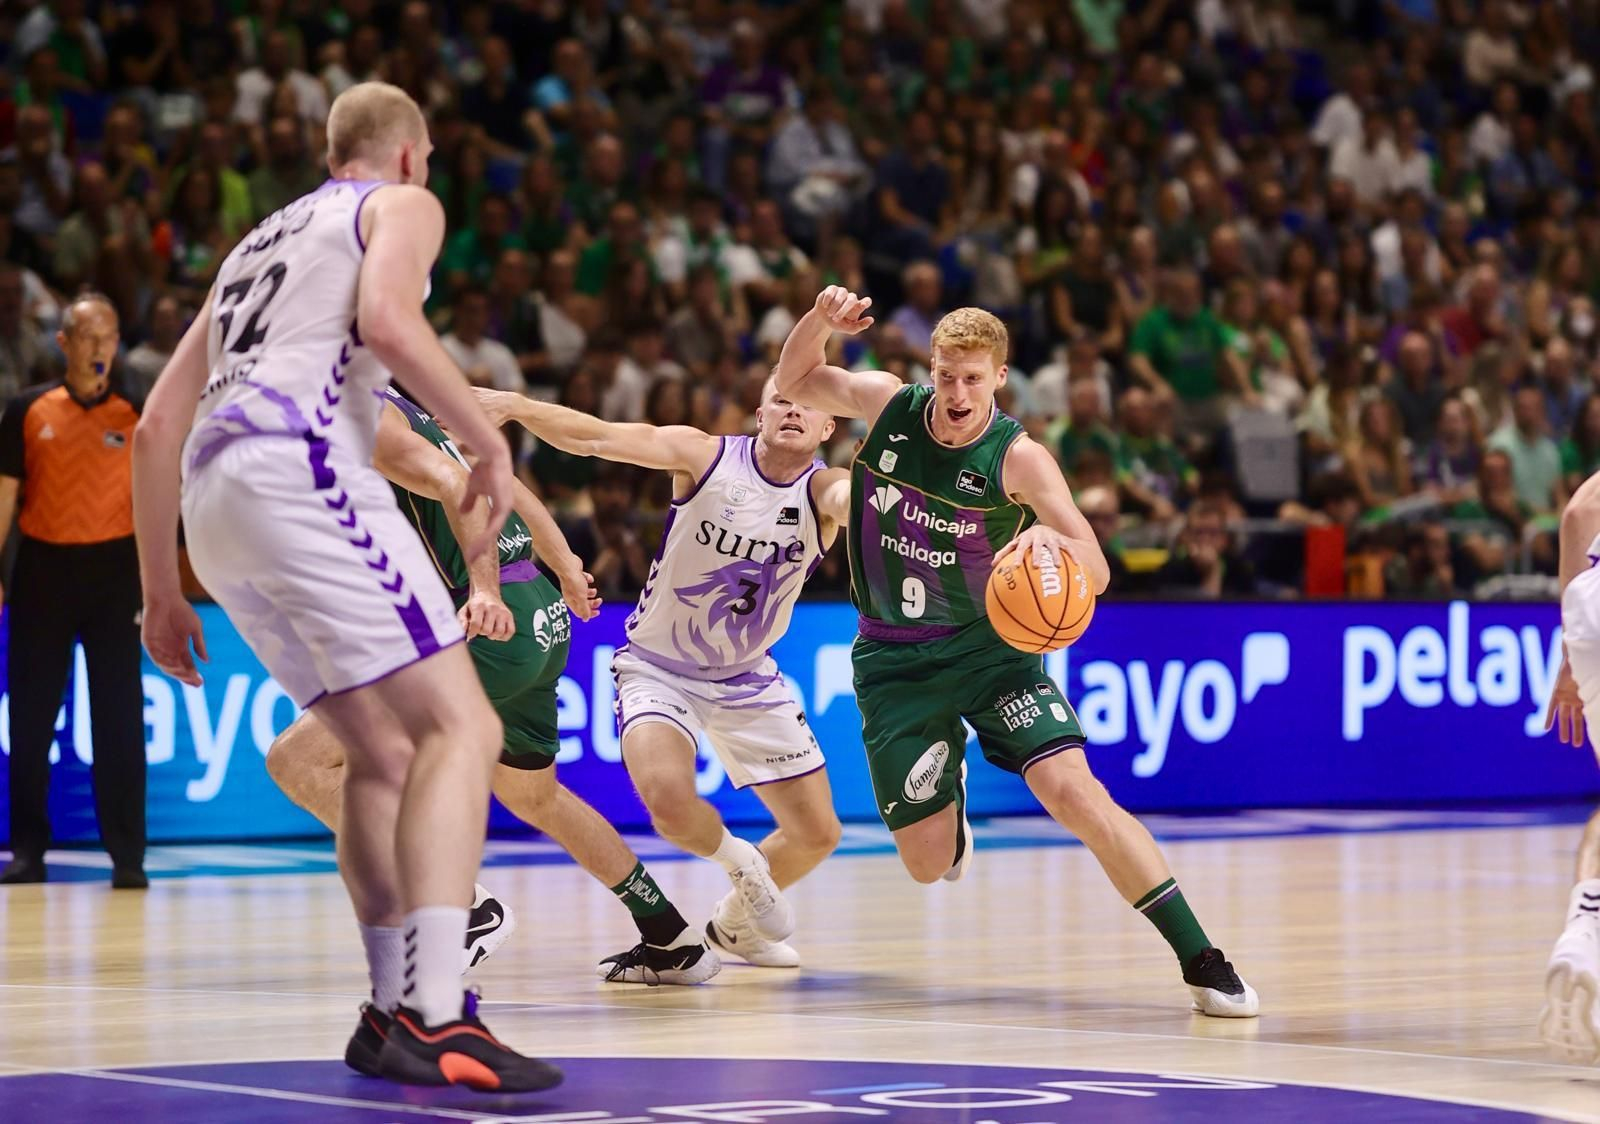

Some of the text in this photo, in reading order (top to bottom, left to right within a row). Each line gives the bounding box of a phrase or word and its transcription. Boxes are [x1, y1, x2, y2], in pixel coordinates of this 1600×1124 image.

[902, 501, 978, 539] Unicaja
[730, 578, 762, 616] 3
[901, 576, 926, 619] 9
[1341, 599, 1564, 742] pelay
[993, 689, 1017, 710] sabor
[1002, 705, 1044, 732] laga
[765, 749, 811, 764] NISSAN
